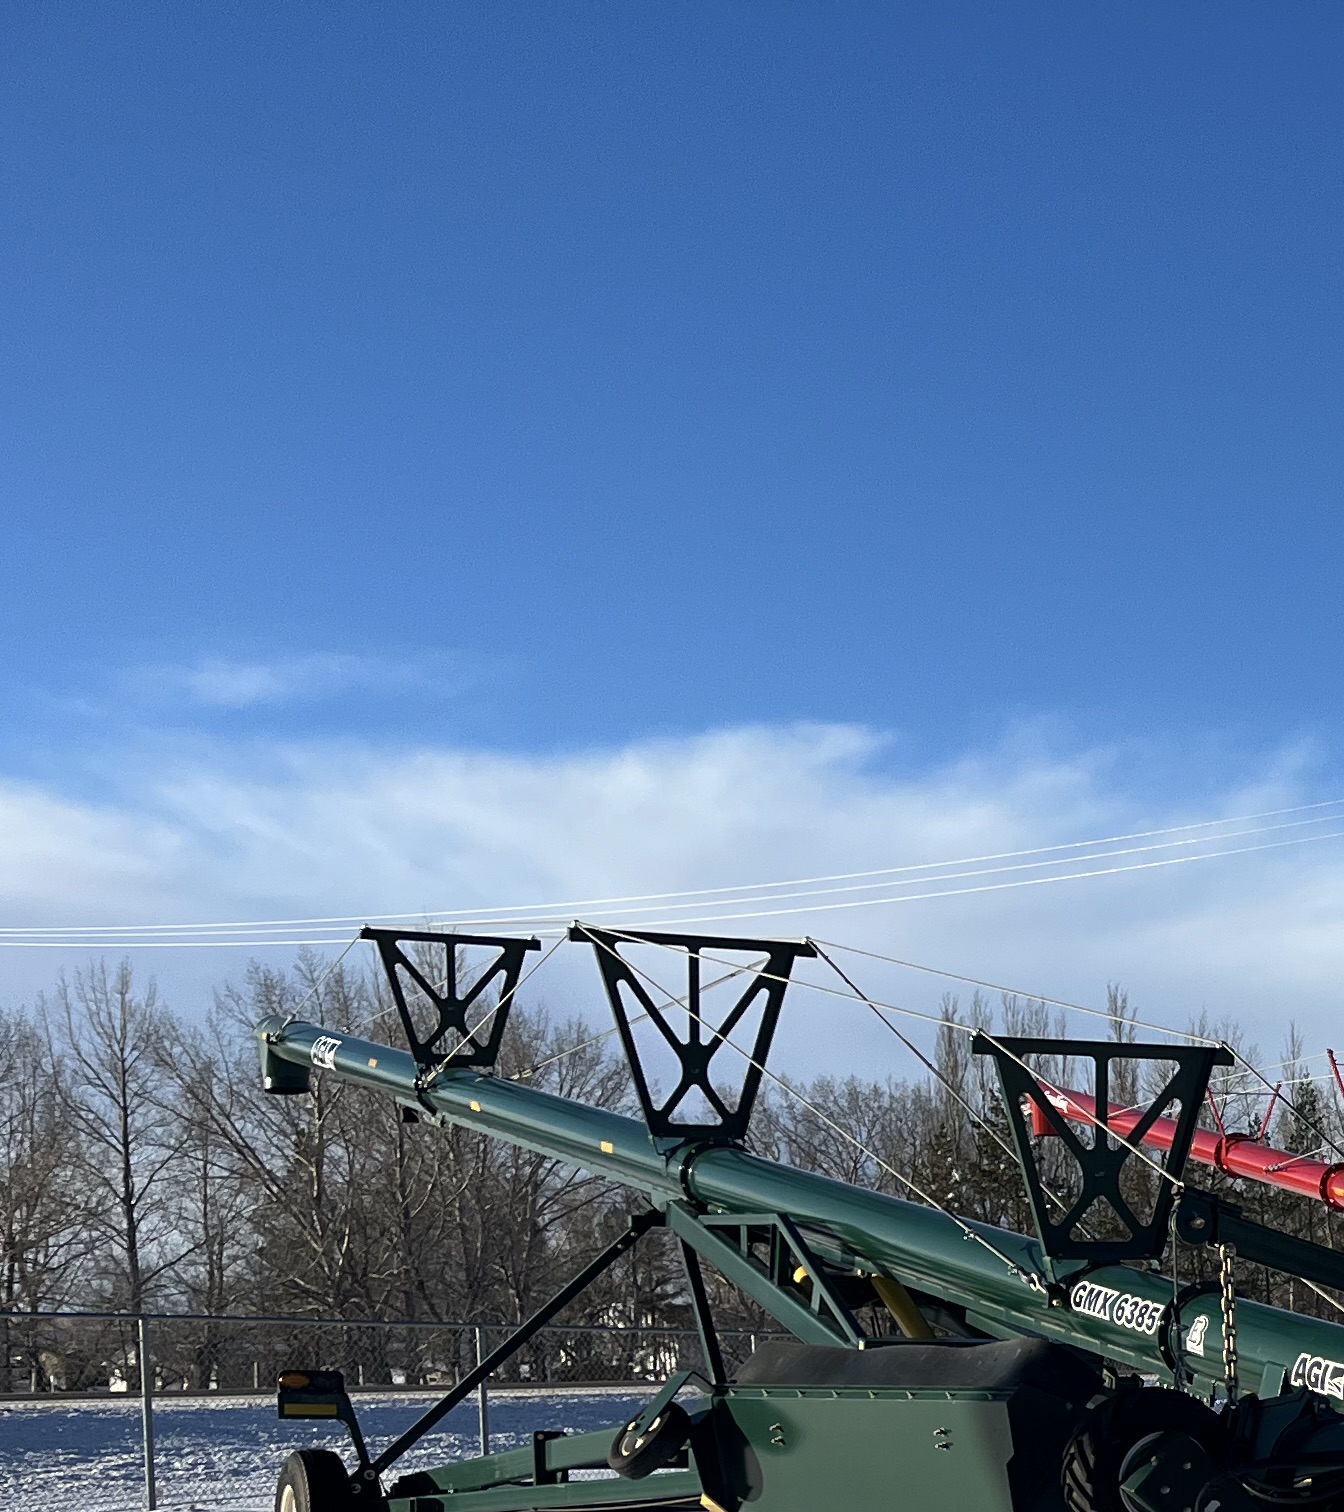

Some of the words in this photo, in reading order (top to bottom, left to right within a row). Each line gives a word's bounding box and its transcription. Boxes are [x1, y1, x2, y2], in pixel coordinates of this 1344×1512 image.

[1071, 1281, 1119, 1320] GMX
[1113, 1294, 1164, 1334] 6385
[1292, 1353, 1329, 1395] AGI
